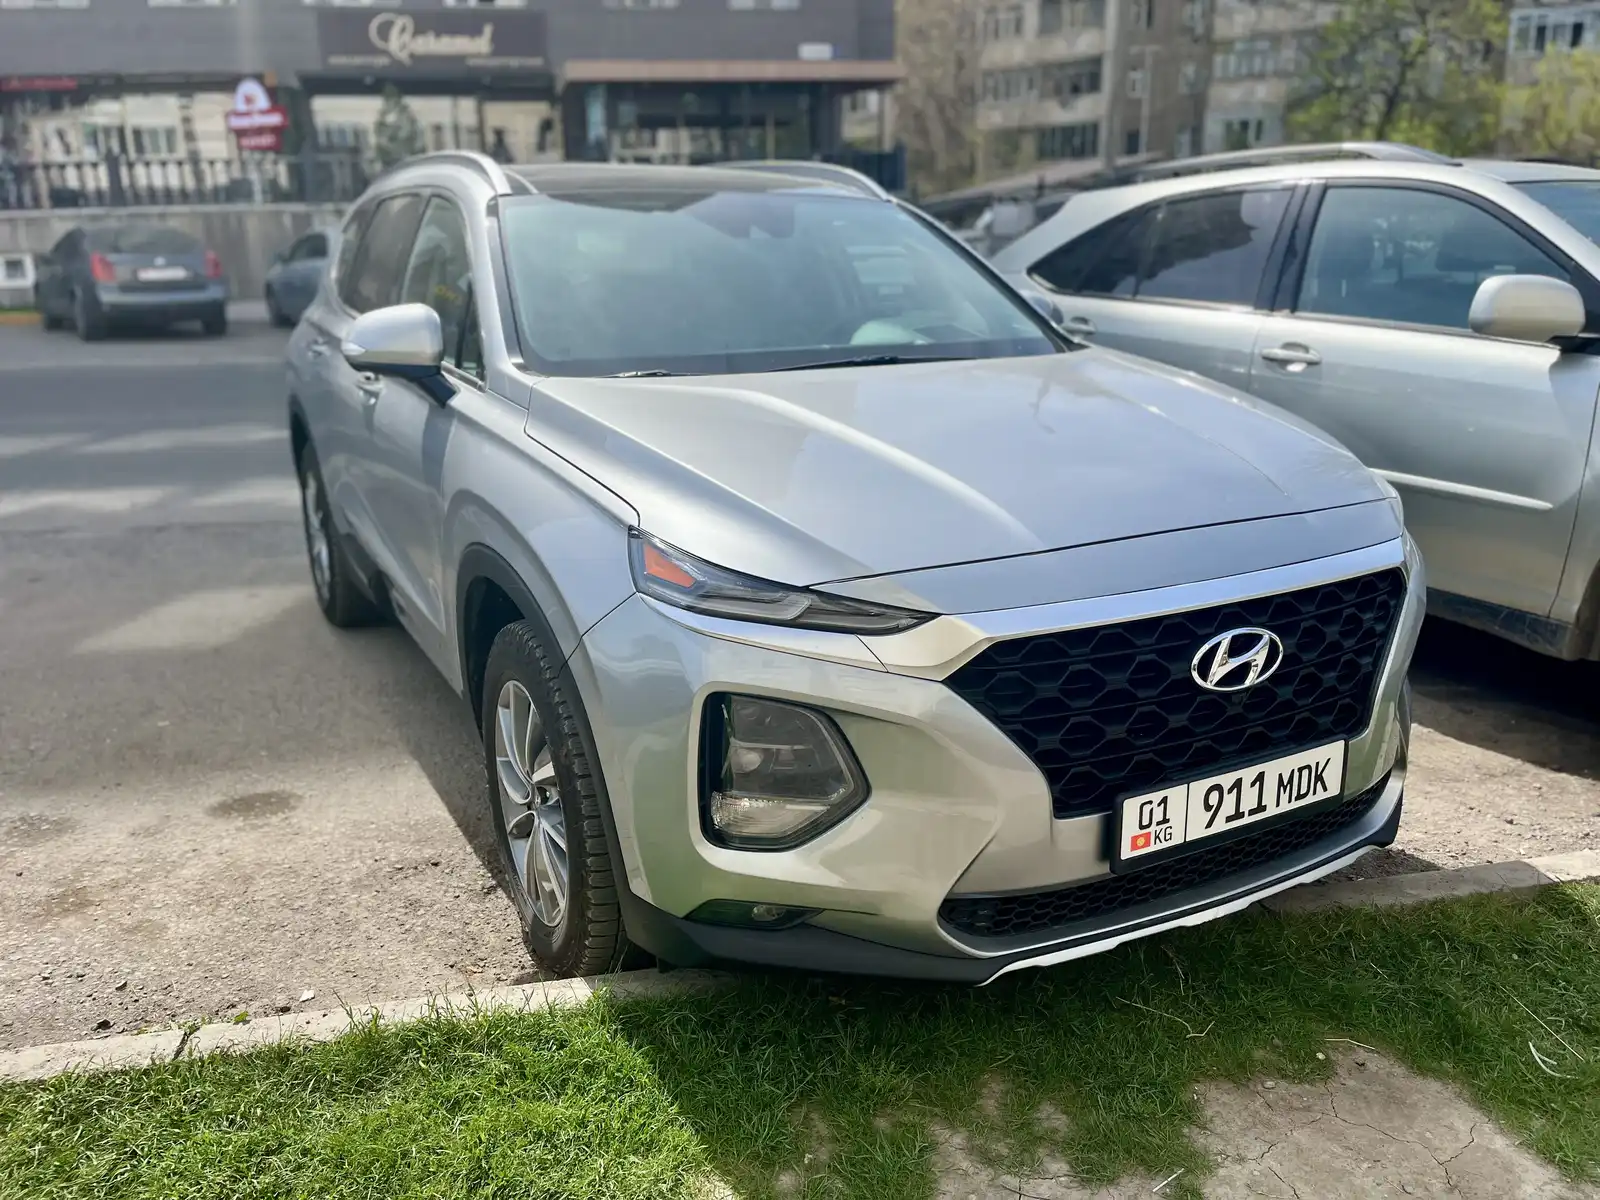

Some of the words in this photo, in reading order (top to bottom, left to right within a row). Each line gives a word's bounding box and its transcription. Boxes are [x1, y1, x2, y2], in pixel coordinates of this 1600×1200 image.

[1138, 795, 1170, 830] 01
[1203, 770, 1267, 830] 911
[1275, 757, 1332, 808] MDK
[1153, 826, 1173, 845] KG
